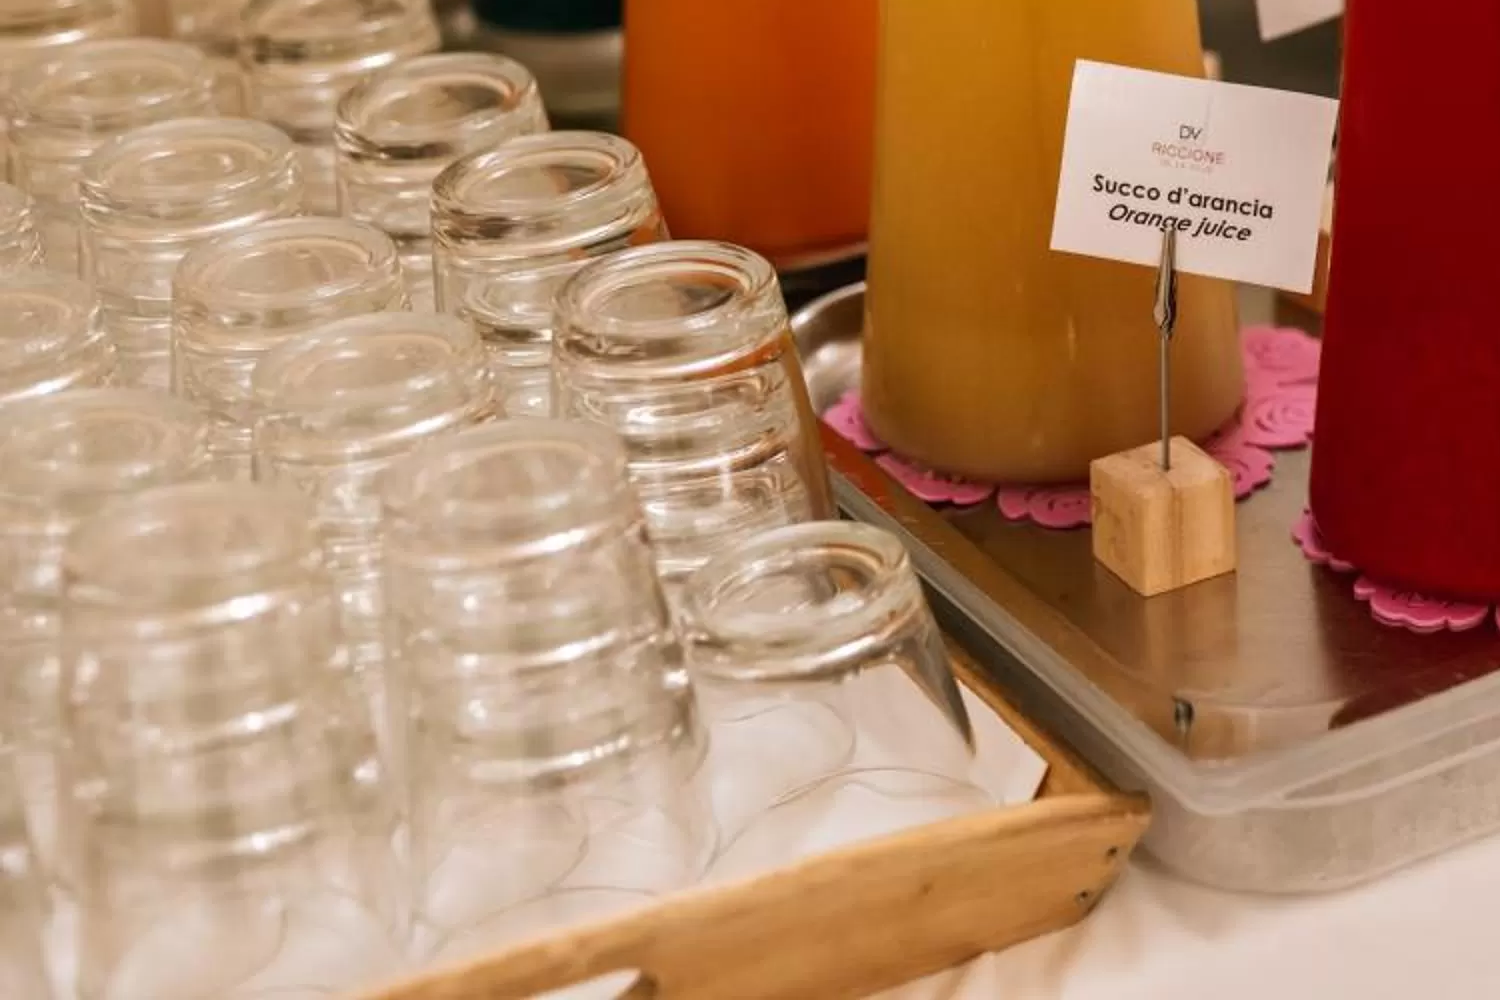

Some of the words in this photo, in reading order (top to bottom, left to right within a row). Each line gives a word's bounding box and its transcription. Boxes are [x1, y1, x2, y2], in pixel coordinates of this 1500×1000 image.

[1179, 124, 1202, 141] DV
[1152, 142, 1225, 164] RICCIONE
[1092, 174, 1161, 201] Succo
[1167, 187, 1273, 219] d'arancia
[1108, 203, 1192, 233] Orange
[1193, 216, 1252, 242] juice
